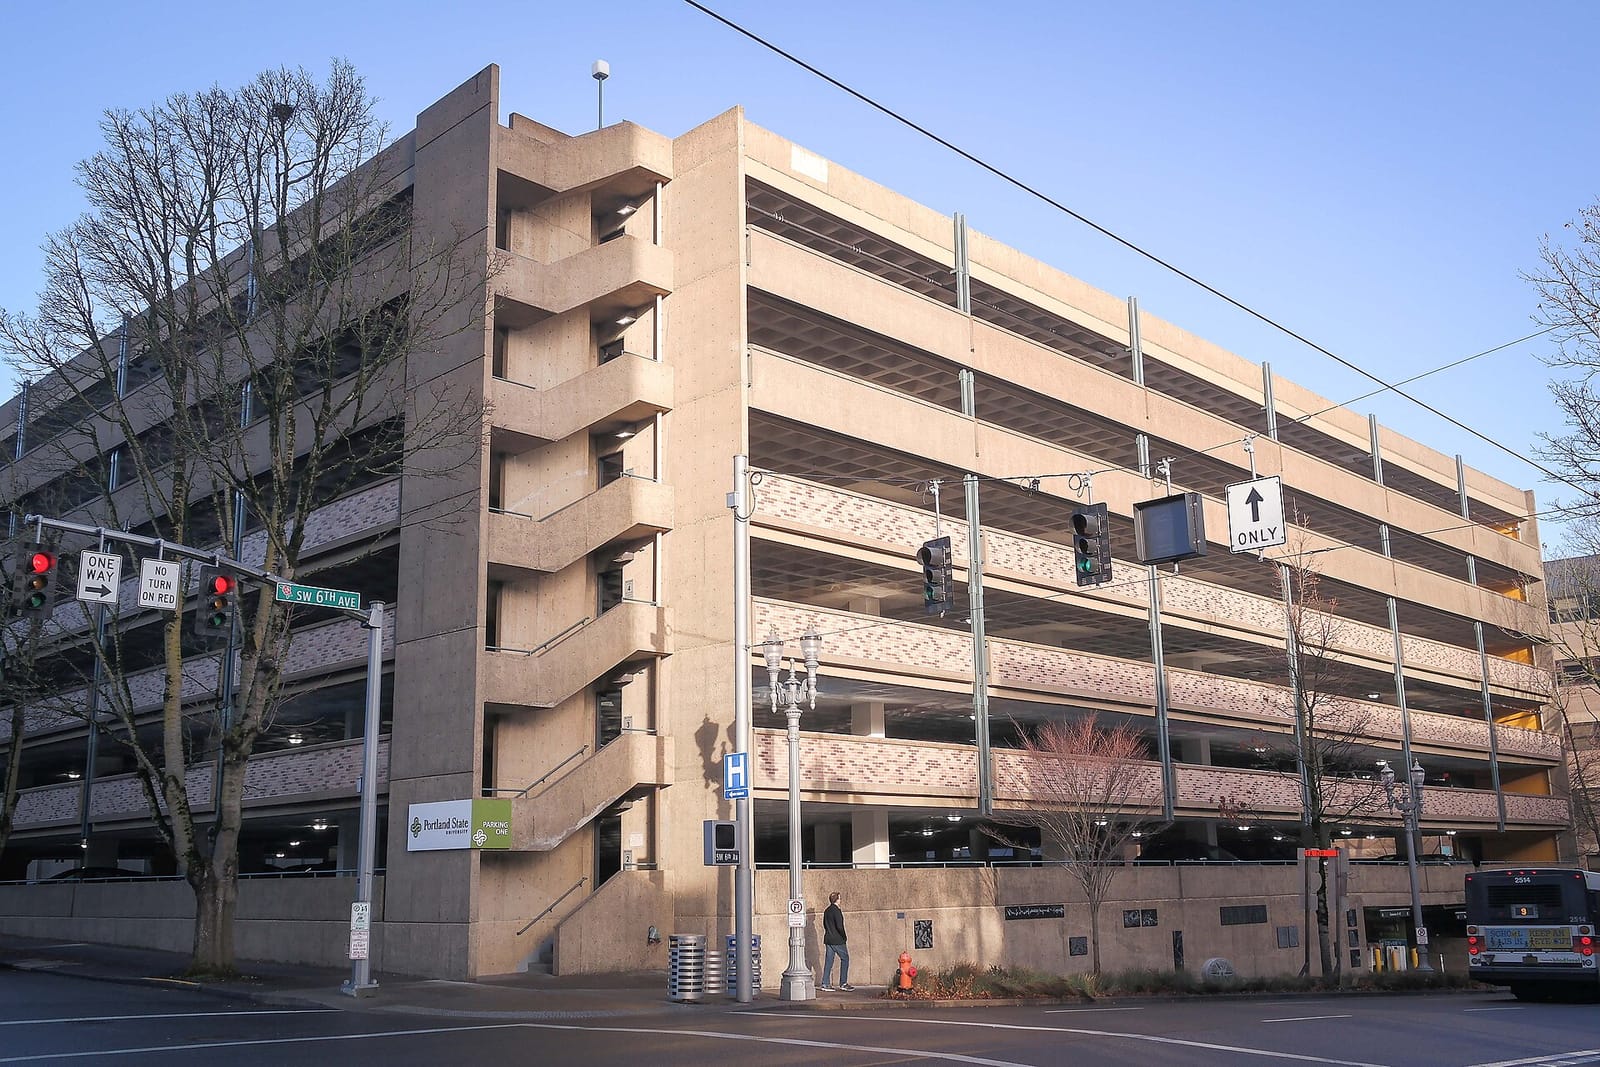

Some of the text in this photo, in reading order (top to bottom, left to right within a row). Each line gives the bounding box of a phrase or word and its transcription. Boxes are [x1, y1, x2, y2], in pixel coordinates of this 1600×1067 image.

[1238, 526, 1278, 545] ONLY
[88, 556, 115, 569] ONE
[86, 569, 115, 582] WAY
[155, 566, 167, 576] NO
[148, 578, 172, 590] TURN
[142, 592, 175, 603] ON RED
[296, 590, 356, 607] SW 6TH AVE
[727, 756, 745, 787] H
[423, 817, 469, 831] Portland State
